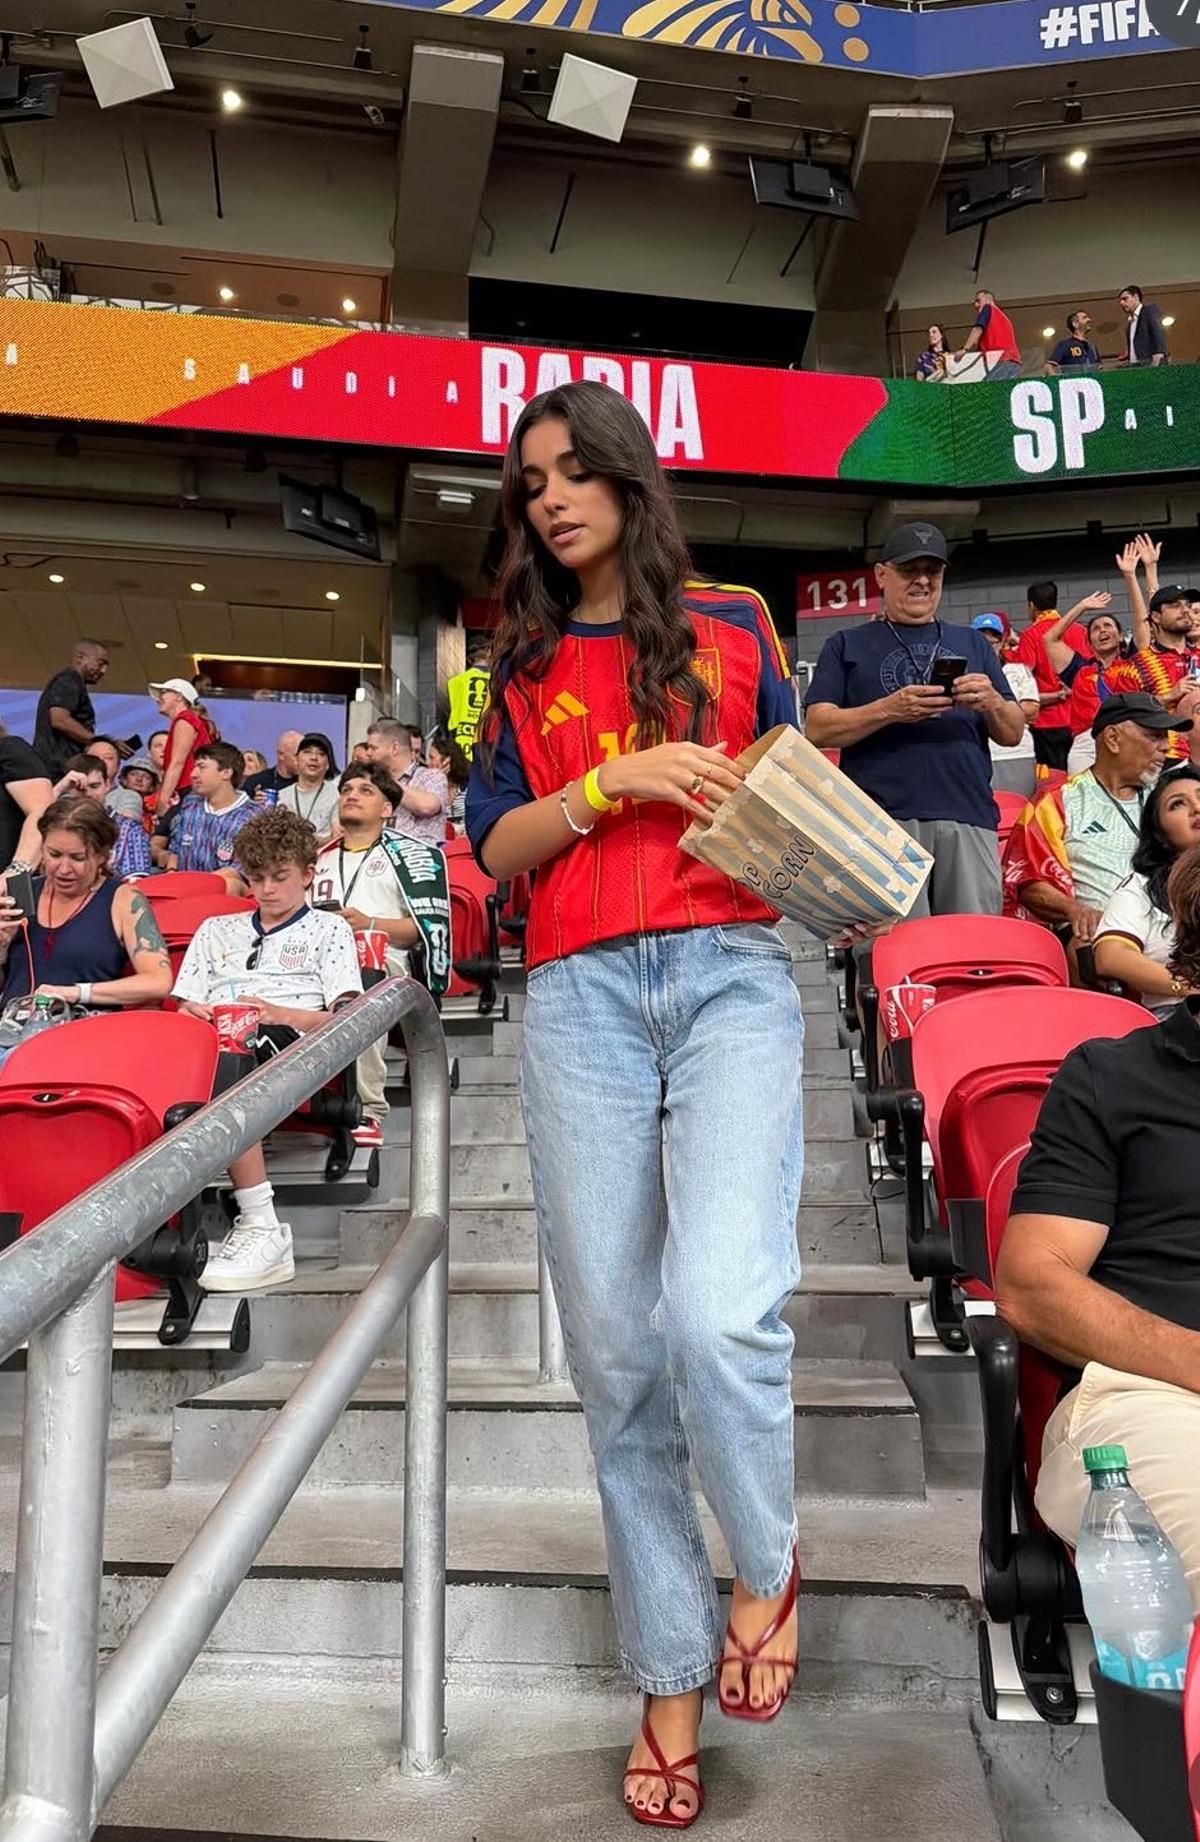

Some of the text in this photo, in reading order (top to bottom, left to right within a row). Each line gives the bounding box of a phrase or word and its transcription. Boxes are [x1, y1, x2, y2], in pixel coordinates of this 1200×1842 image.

[1070, 346, 1082, 358] 10
[807, 577, 867, 611] 131
[762, 834, 815, 899] CORN
[284, 946, 306, 956] USA
